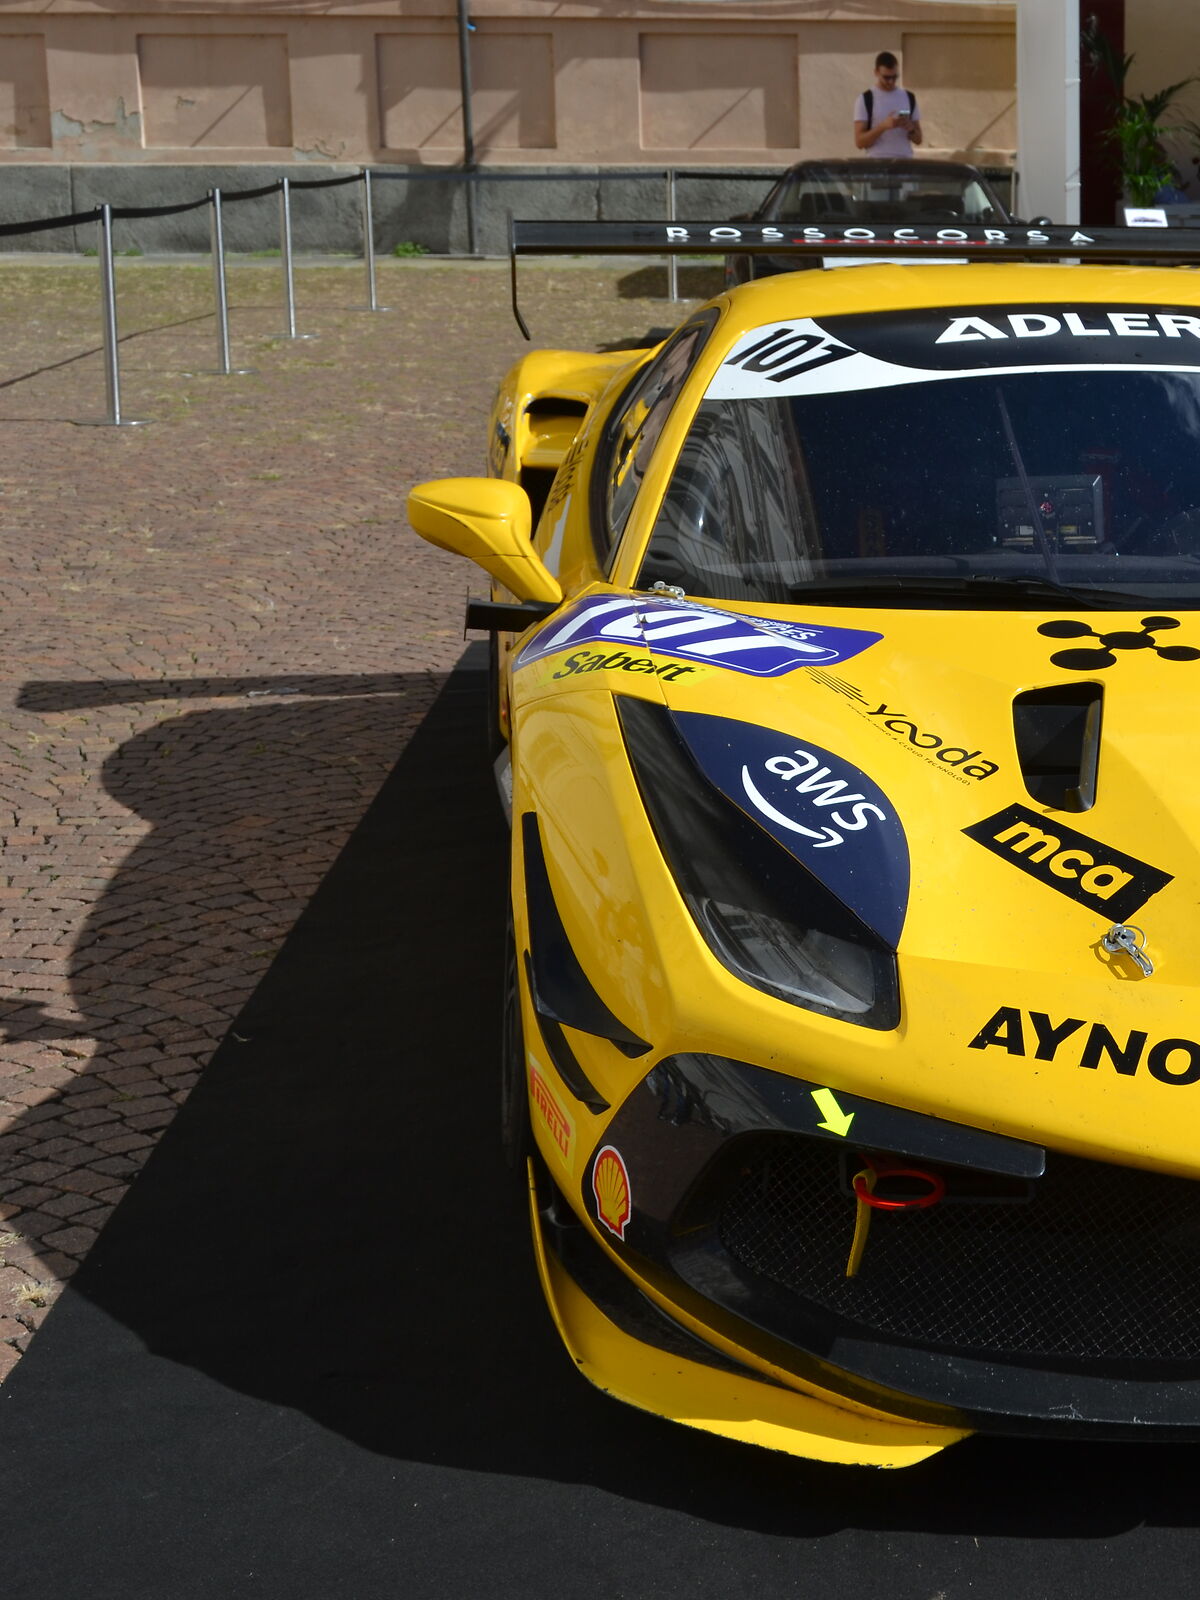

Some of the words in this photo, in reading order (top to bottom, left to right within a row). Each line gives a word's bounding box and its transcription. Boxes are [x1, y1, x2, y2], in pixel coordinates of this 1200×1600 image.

[667, 227, 1095, 242] ROSSOCORSA
[724, 326, 856, 382] 107
[543, 598, 826, 656] 107
[553, 650, 694, 681] Sabelt
[764, 749, 887, 833] aws
[993, 821, 1135, 901] mca
[530, 1065, 571, 1158] PIRELLI
